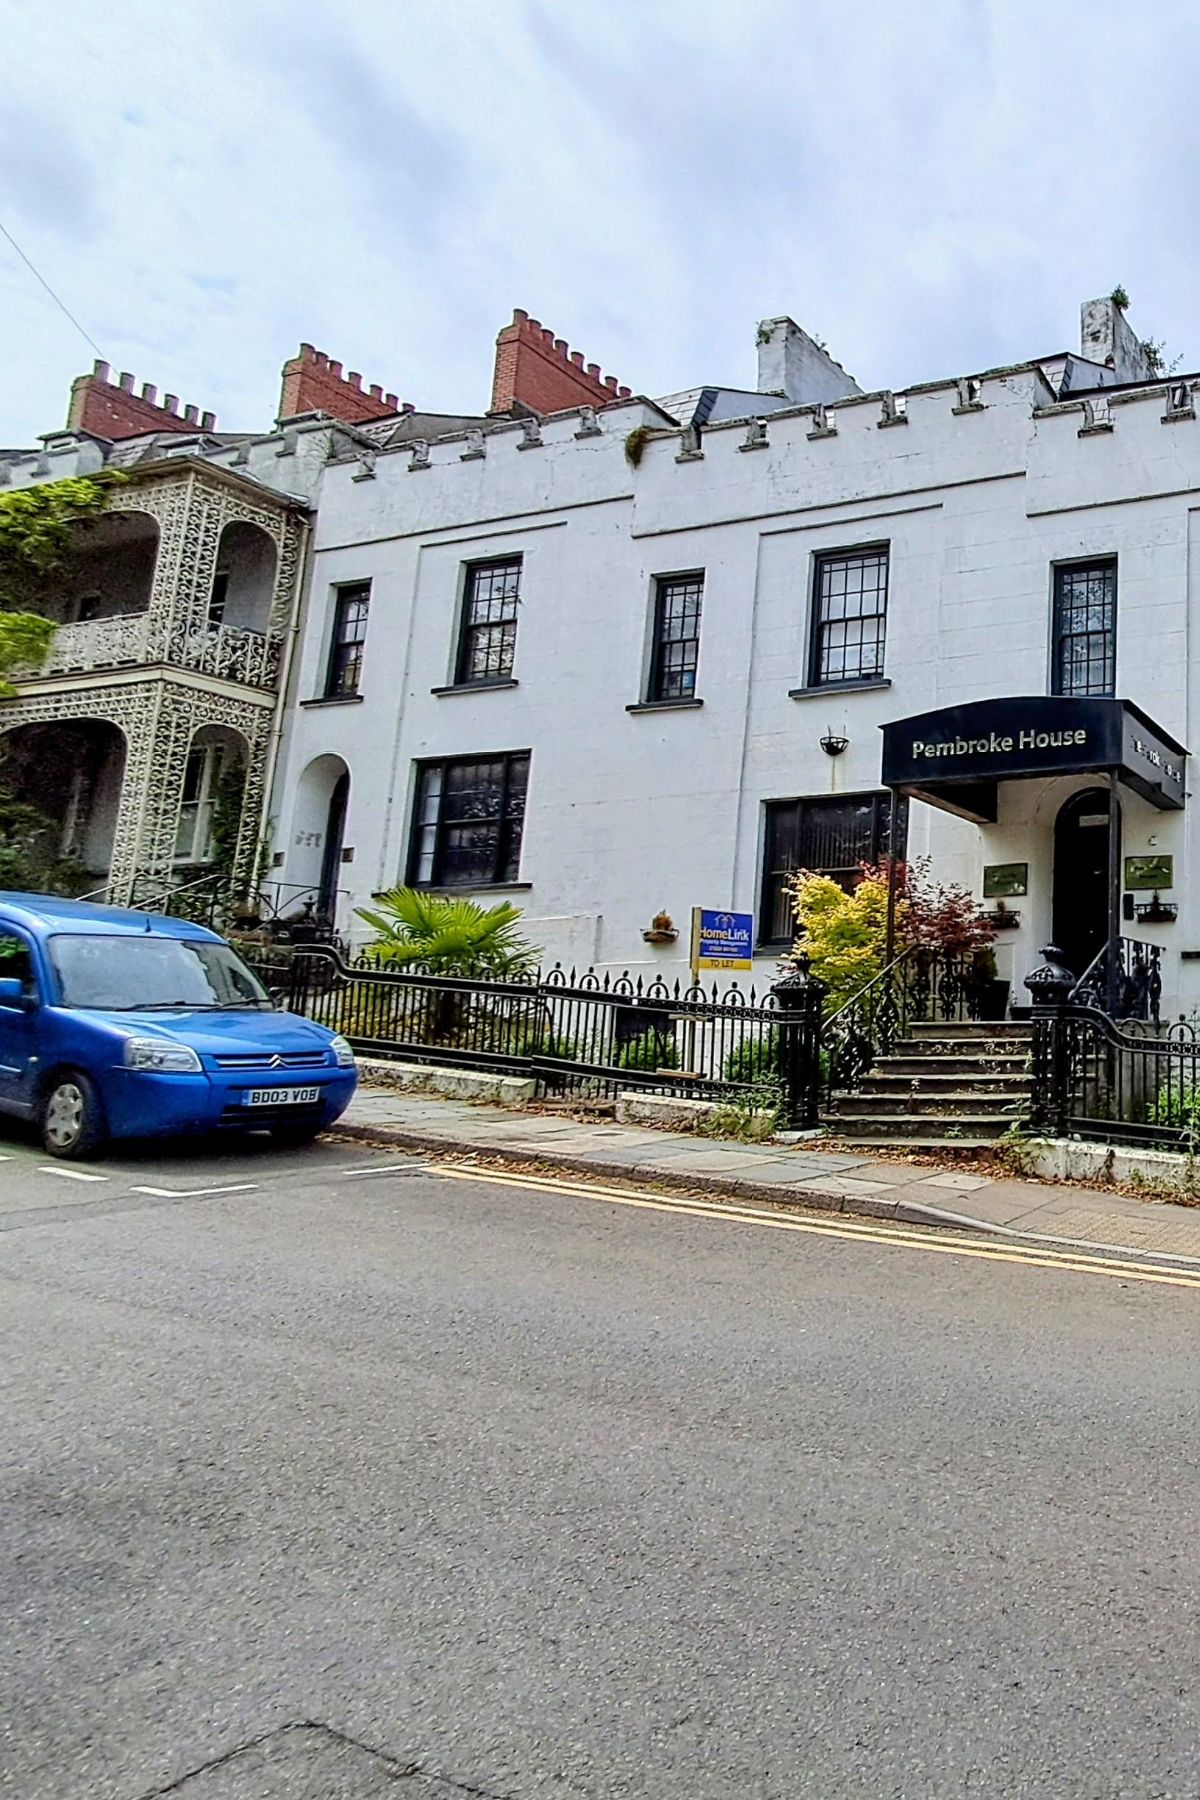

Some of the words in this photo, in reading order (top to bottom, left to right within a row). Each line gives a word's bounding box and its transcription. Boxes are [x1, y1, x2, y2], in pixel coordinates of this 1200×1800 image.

[912, 732, 1013, 759] Pembroke
[1019, 729, 1087, 749] House
[700, 926, 750, 941] HomeLink
[710, 959, 720, 968] TO
[721, 959, 735, 968] LET
[252, 1090, 288, 1103] BD03
